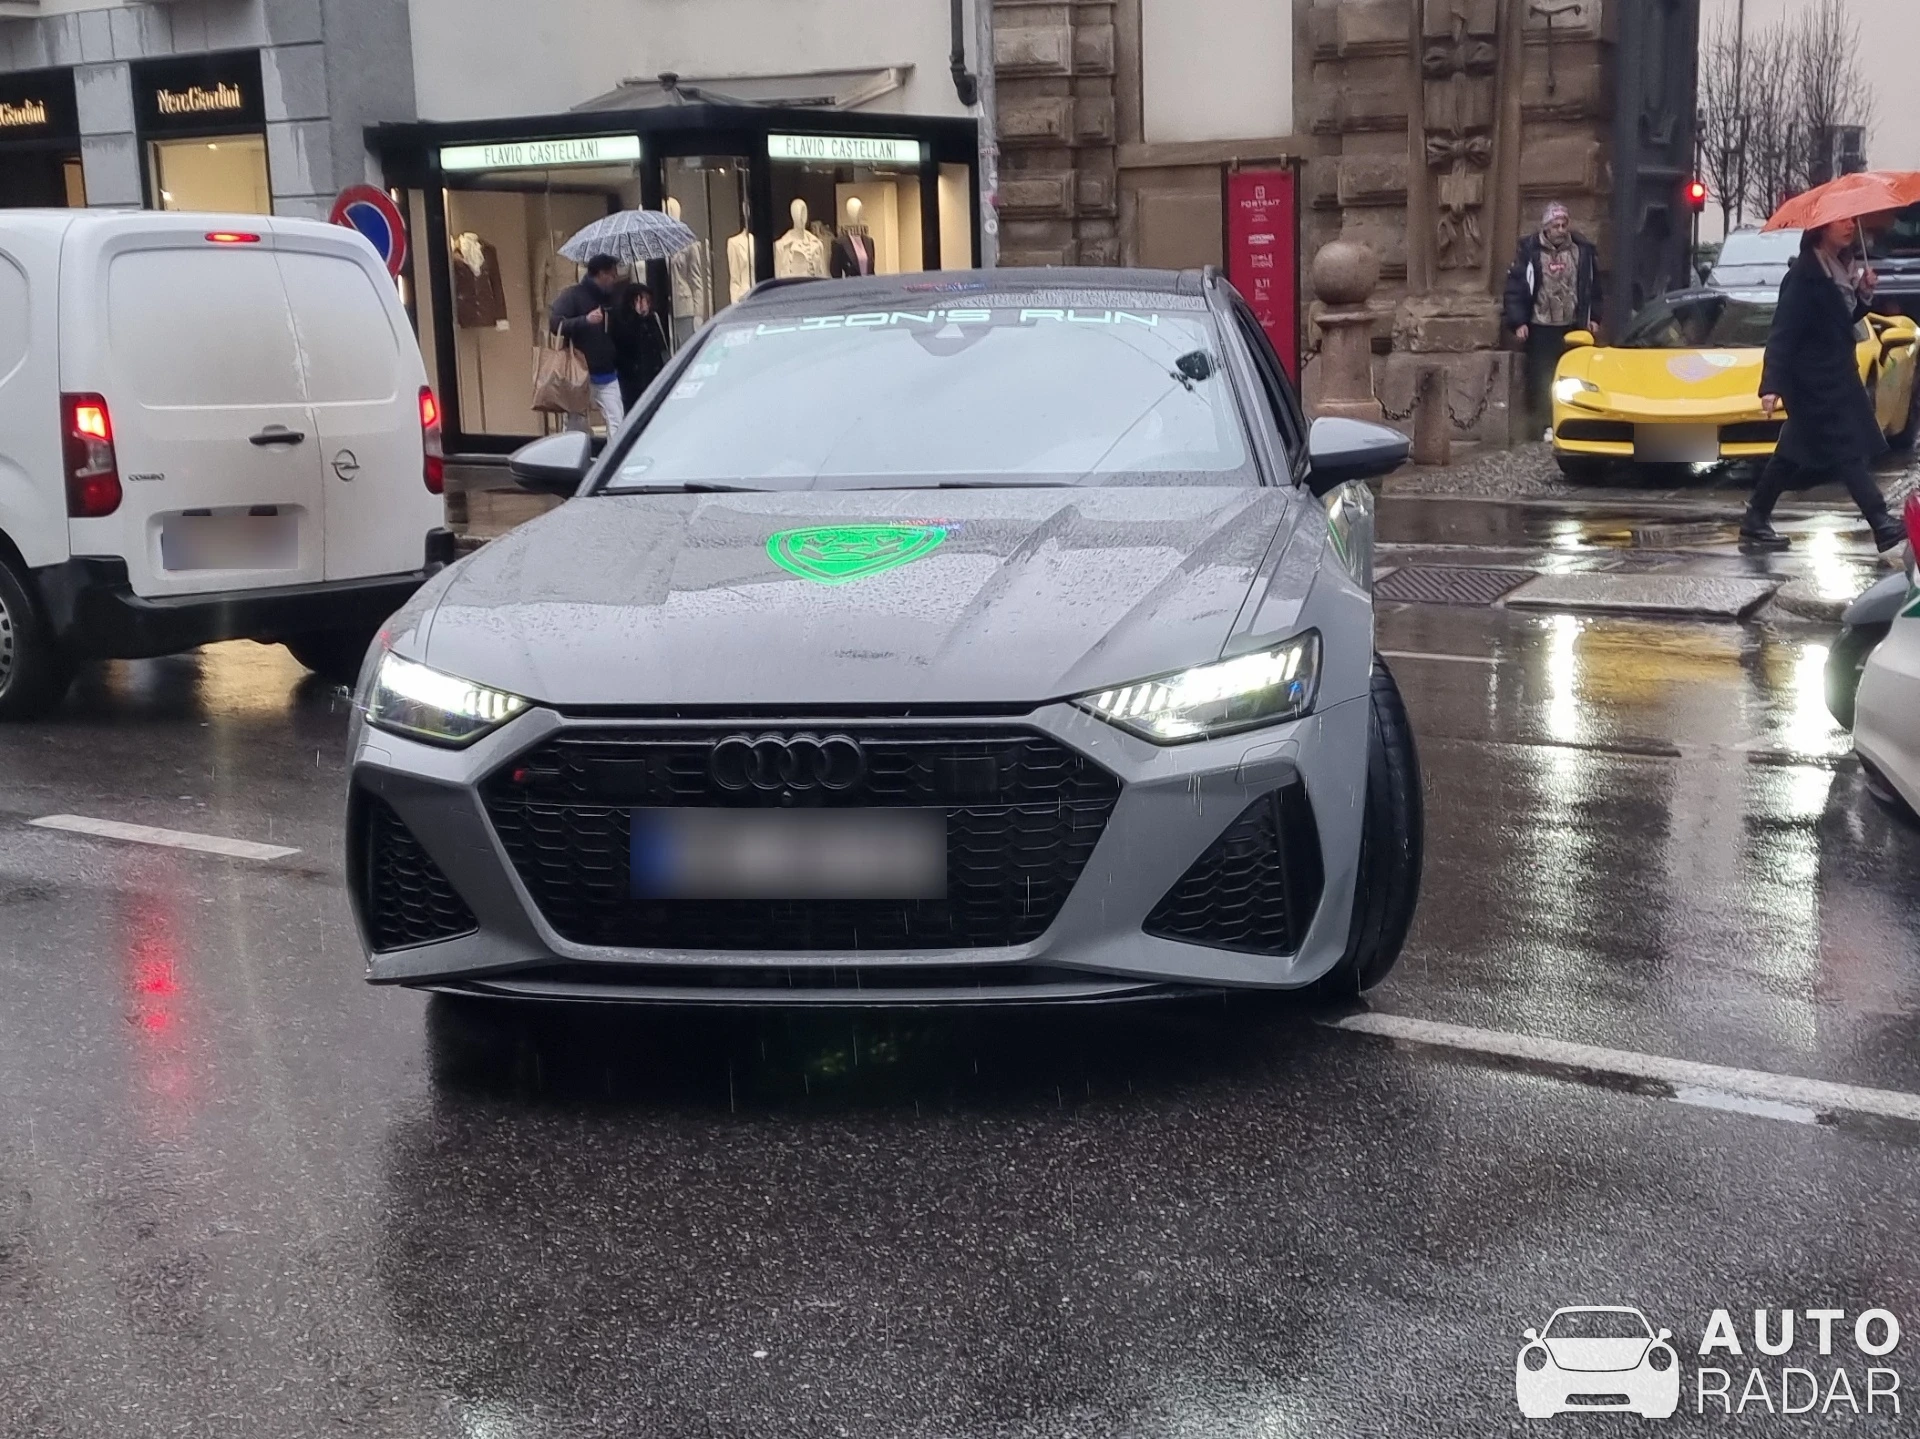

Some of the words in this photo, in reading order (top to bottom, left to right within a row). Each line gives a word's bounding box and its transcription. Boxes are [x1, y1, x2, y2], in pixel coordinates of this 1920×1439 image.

[484, 145, 523, 165] FLAVIO
[528, 141, 600, 163] CASTELLANI
[785, 137, 825, 157] FLAVIO
[831, 139, 897, 159] CASTELLANI
[1240, 199, 1281, 208] PORTRAIT
[756, 309, 992, 336] LION'S
[1019, 309, 1159, 327] RUN
[128, 472, 165, 482] COMBO
